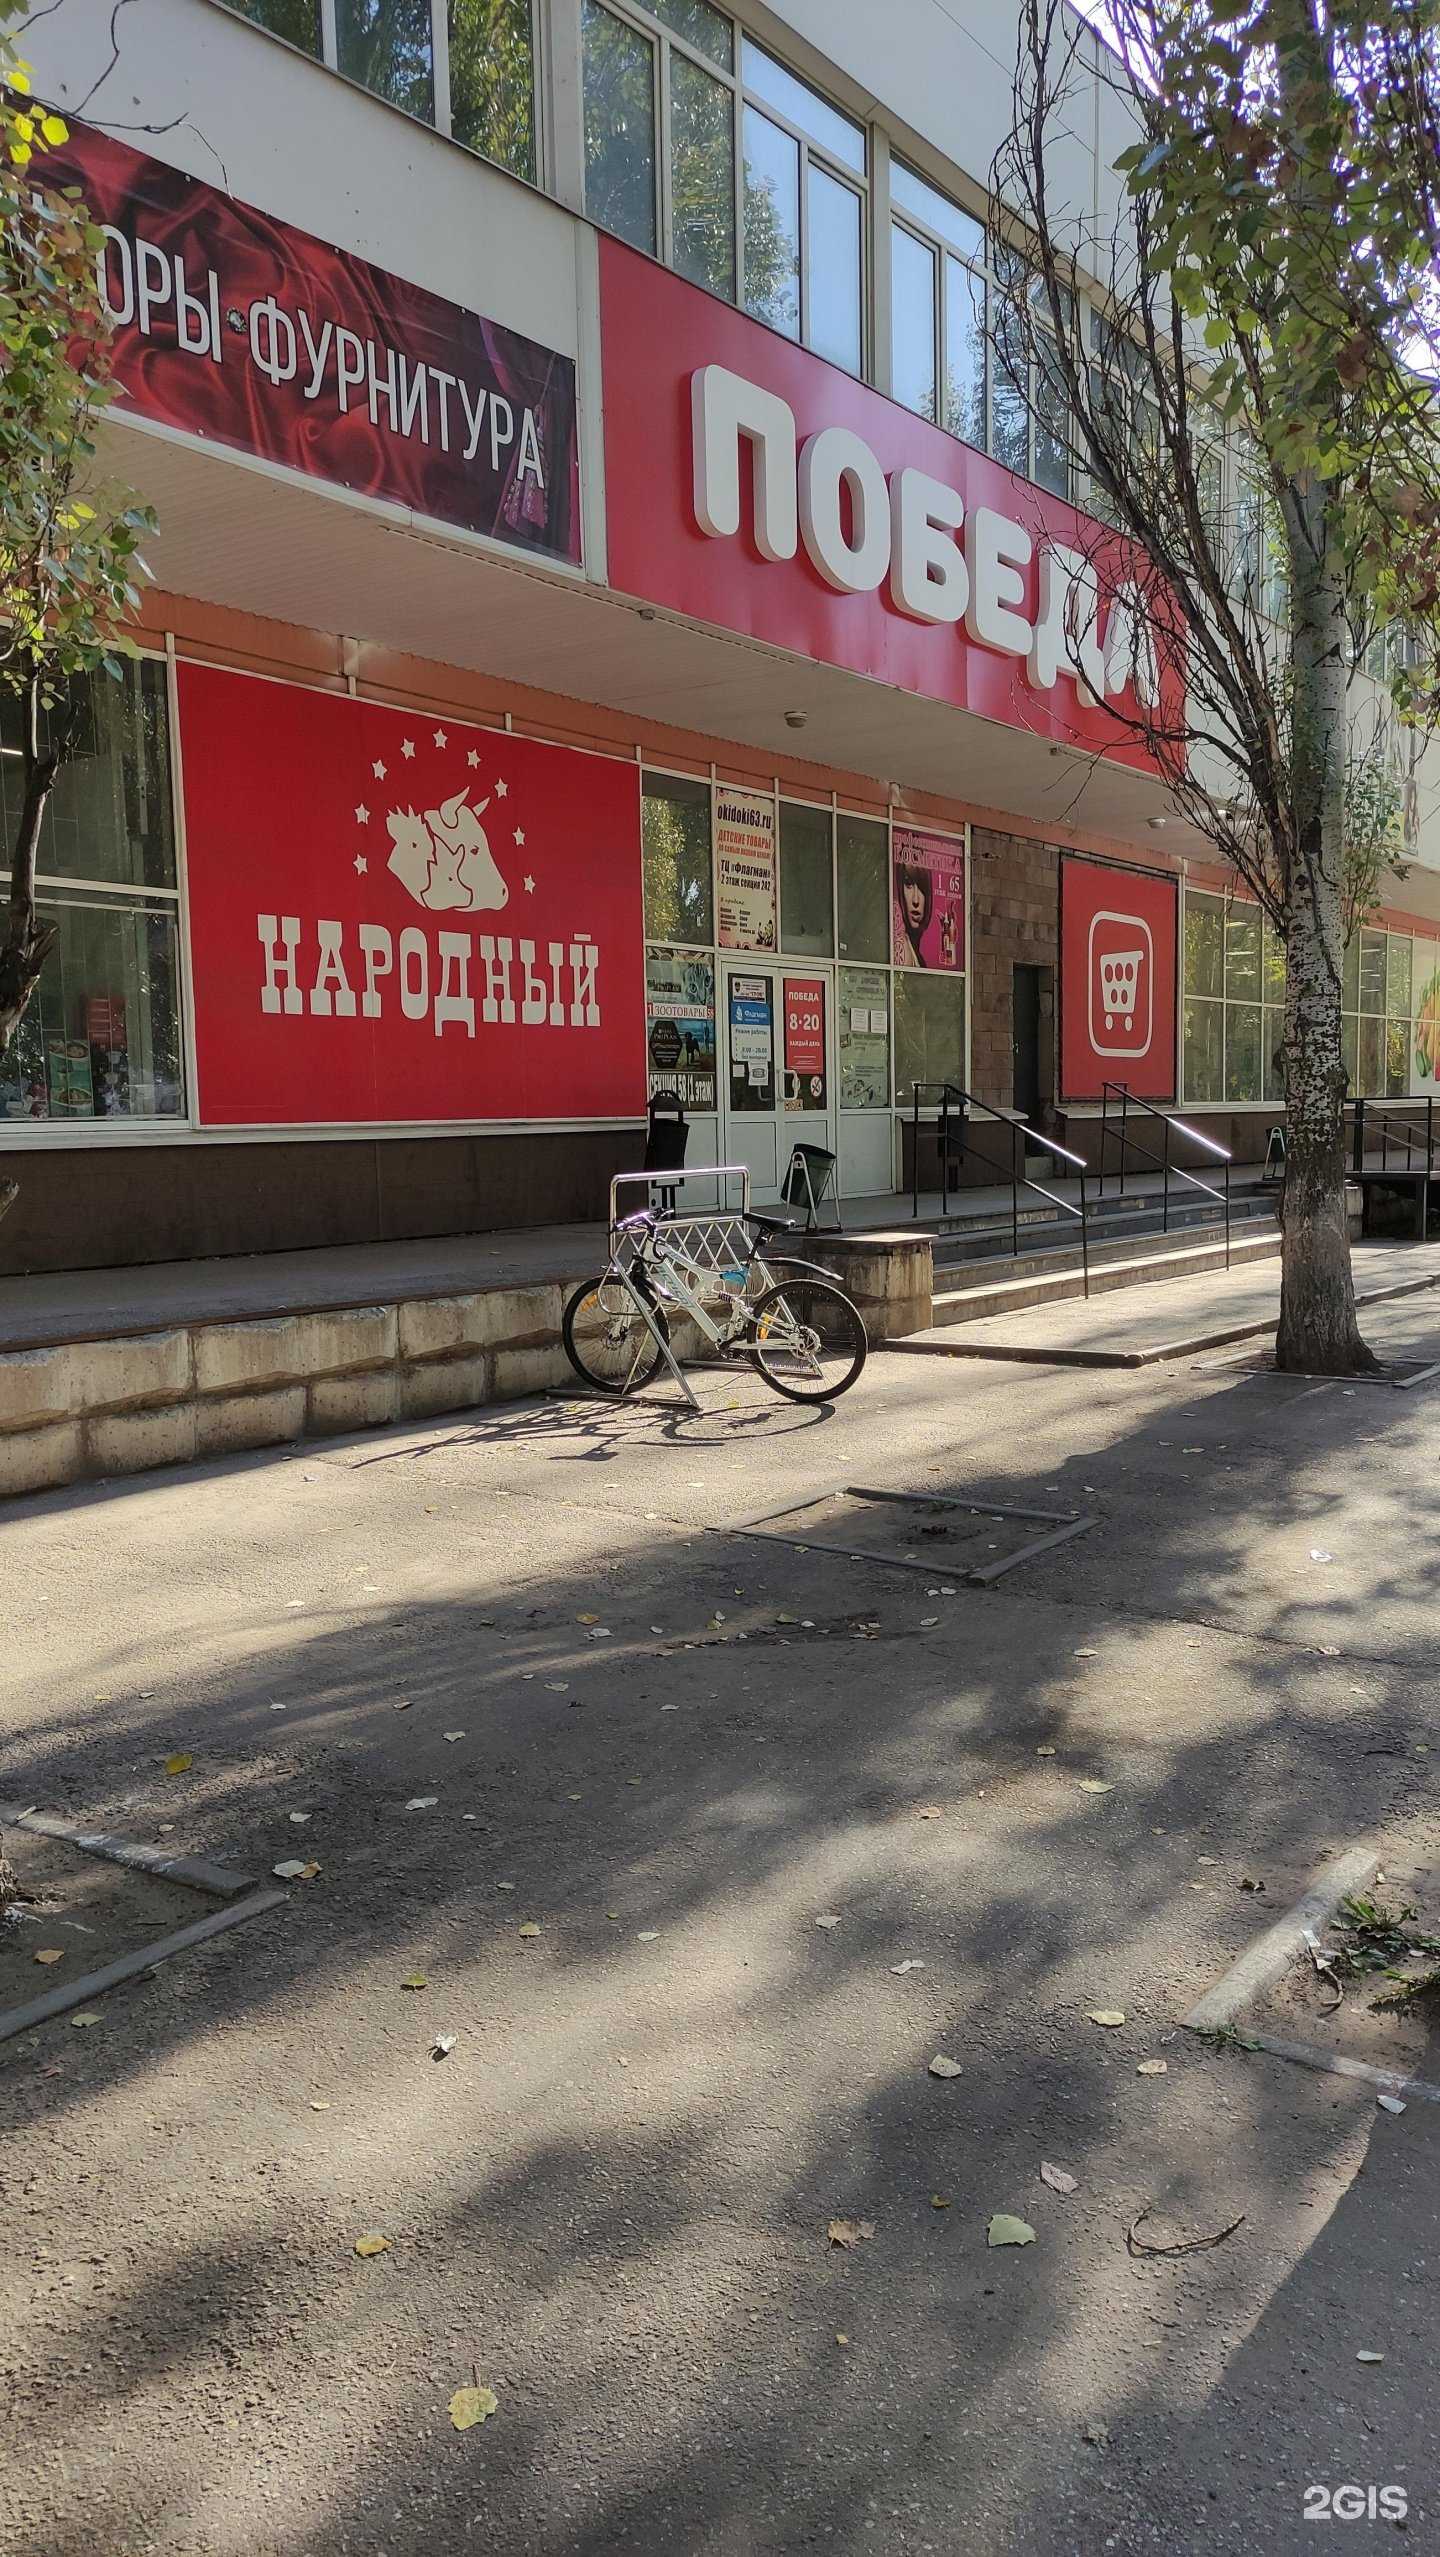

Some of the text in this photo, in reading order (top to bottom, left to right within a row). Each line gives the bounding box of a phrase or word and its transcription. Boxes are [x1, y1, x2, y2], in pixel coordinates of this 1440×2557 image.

[249, 295, 544, 489] ФУРНИТУРА
[691, 364, 1159, 708] ПОБЕДА
[717, 804, 772, 829] okidoki63.ru
[718, 829, 771, 849] ДЕТСКИЕ ТОВАРЫ
[721, 860, 730, 873] ТЦ
[721, 874, 725, 885] 2
[726, 877, 740, 887] этаж
[949, 875, 960, 892] 65
[257, 914, 601, 1037] НАРОДНЫЙ
[788, 991, 819, 1002] ПОБЕДА
[655, 1005, 705, 1017] ЗООТОВАРЫ
[678, 1074, 687, 1102] 58
